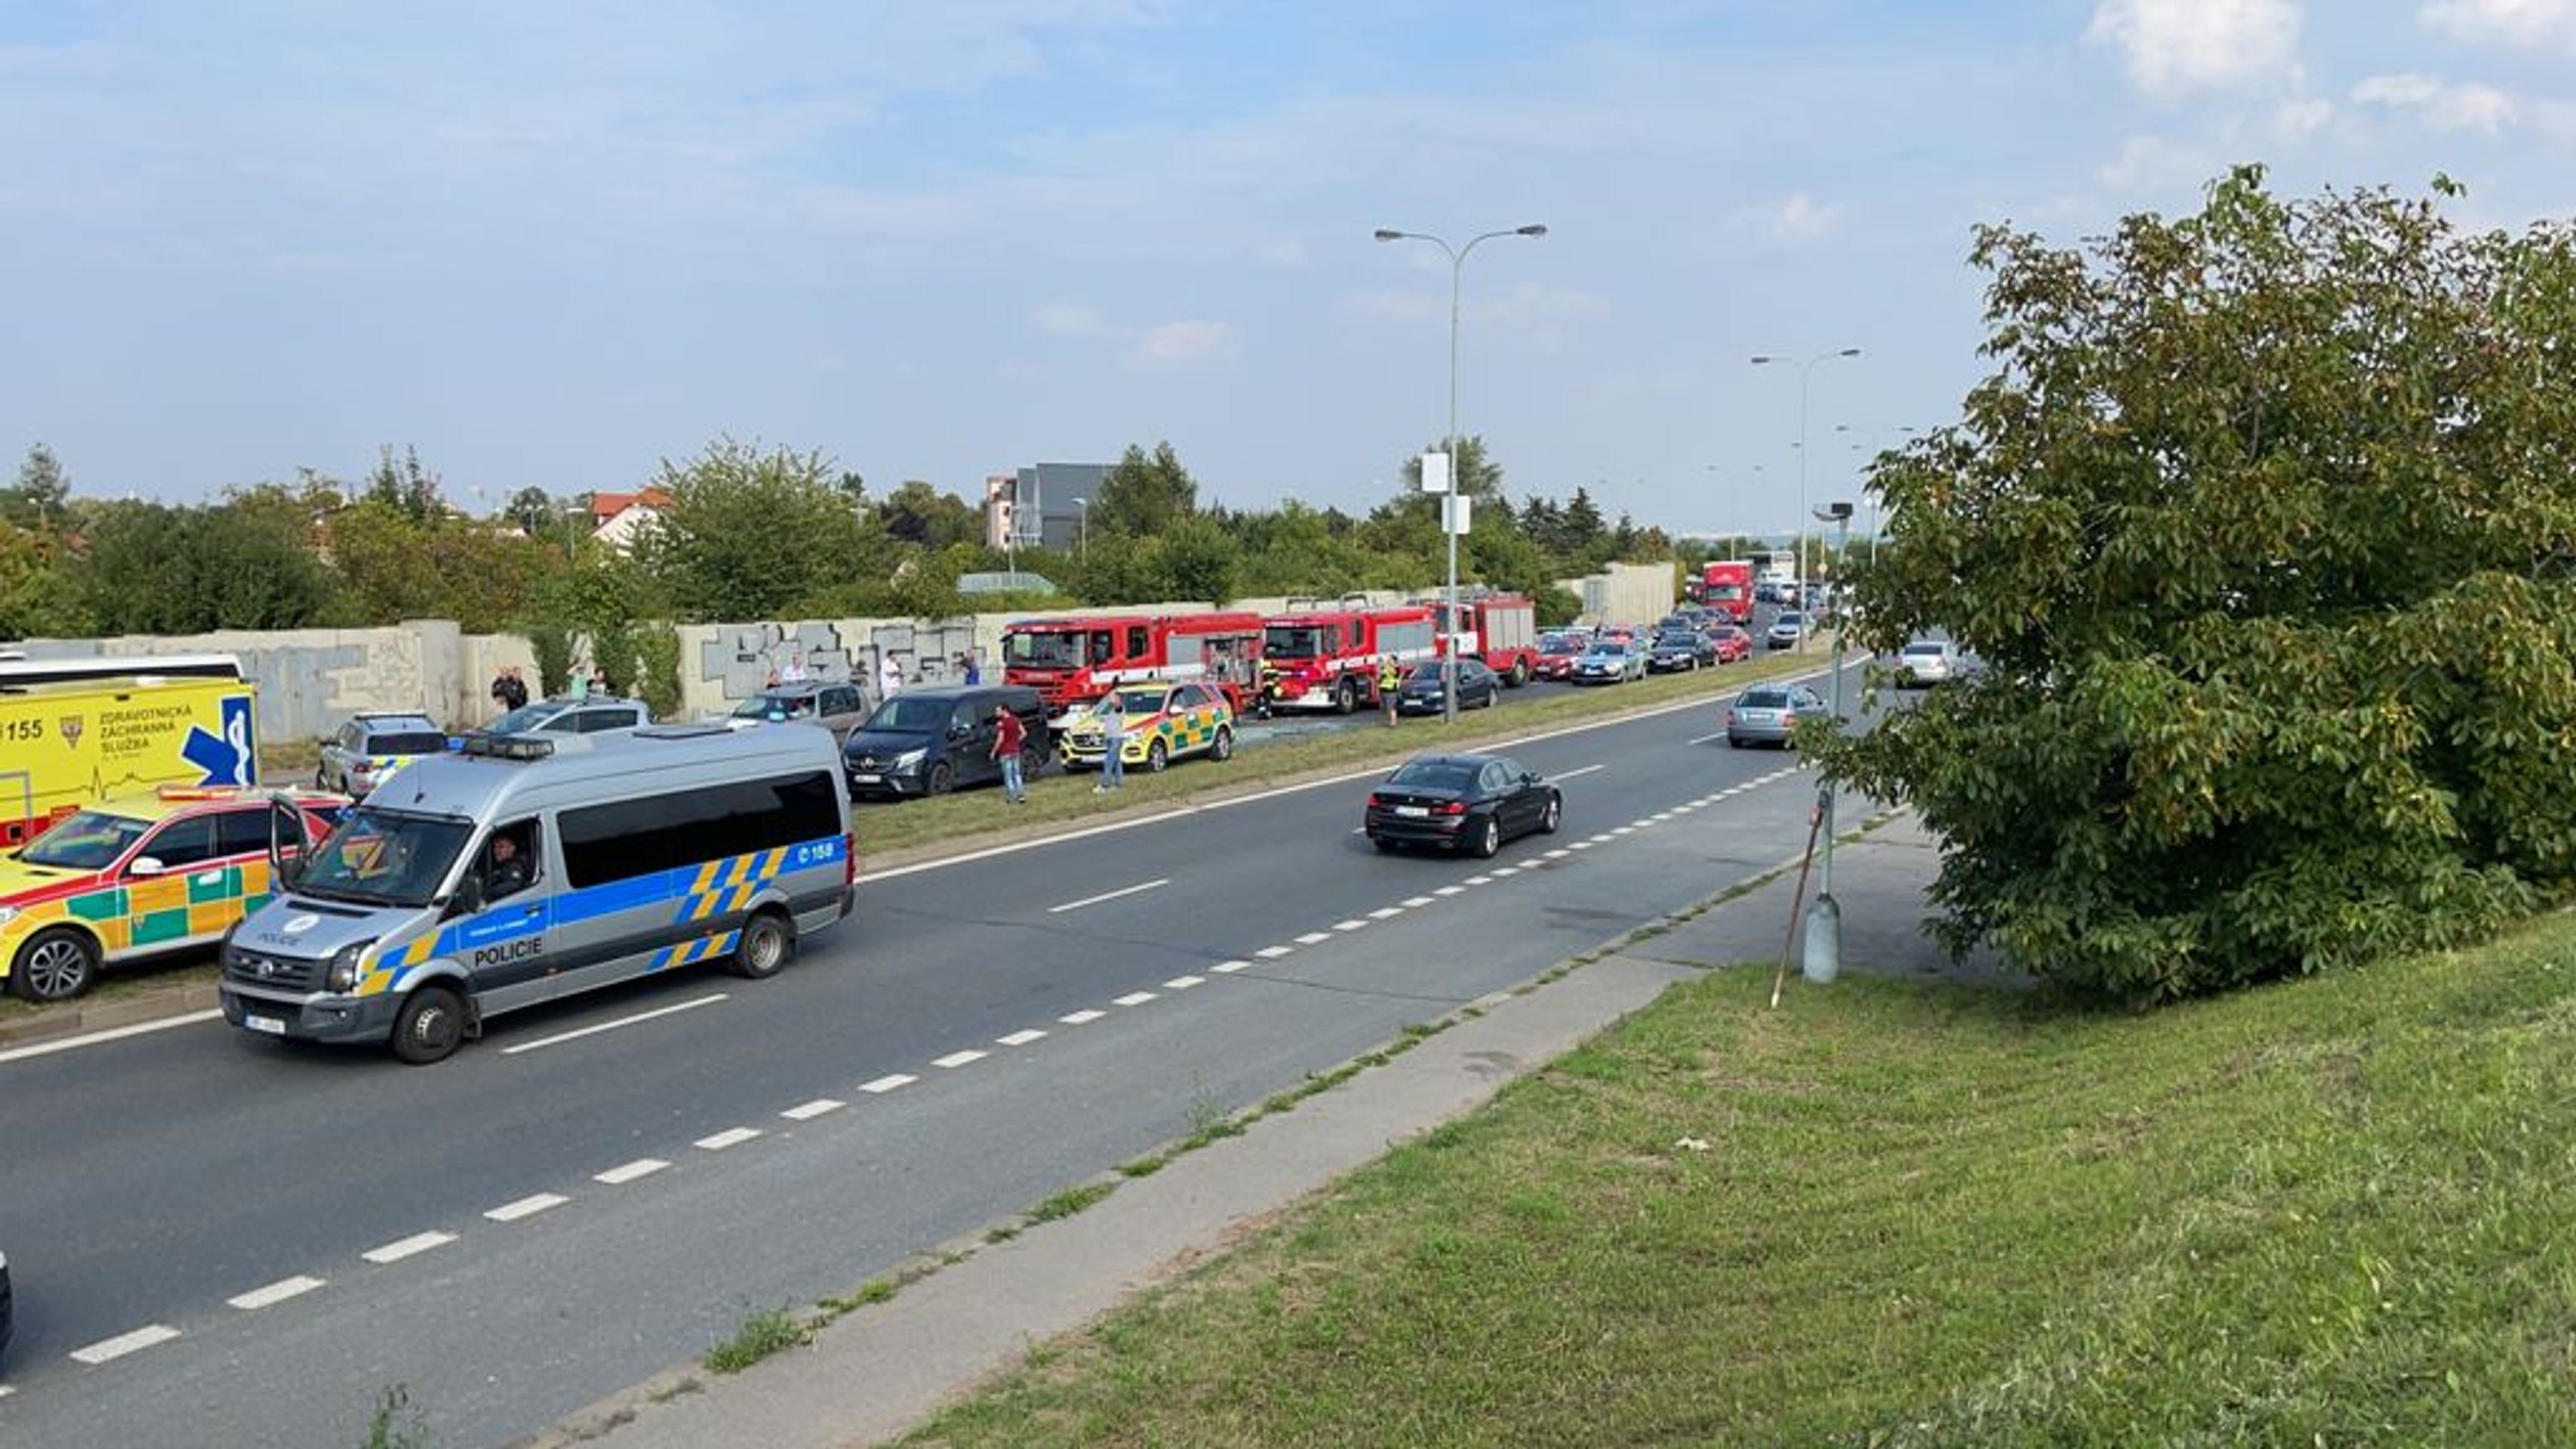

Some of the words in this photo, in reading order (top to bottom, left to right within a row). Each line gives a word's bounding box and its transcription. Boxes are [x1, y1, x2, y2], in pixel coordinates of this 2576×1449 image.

[6, 719, 43, 741] 155
[812, 842, 833, 861] 158
[475, 937, 542, 967] POLICIE
